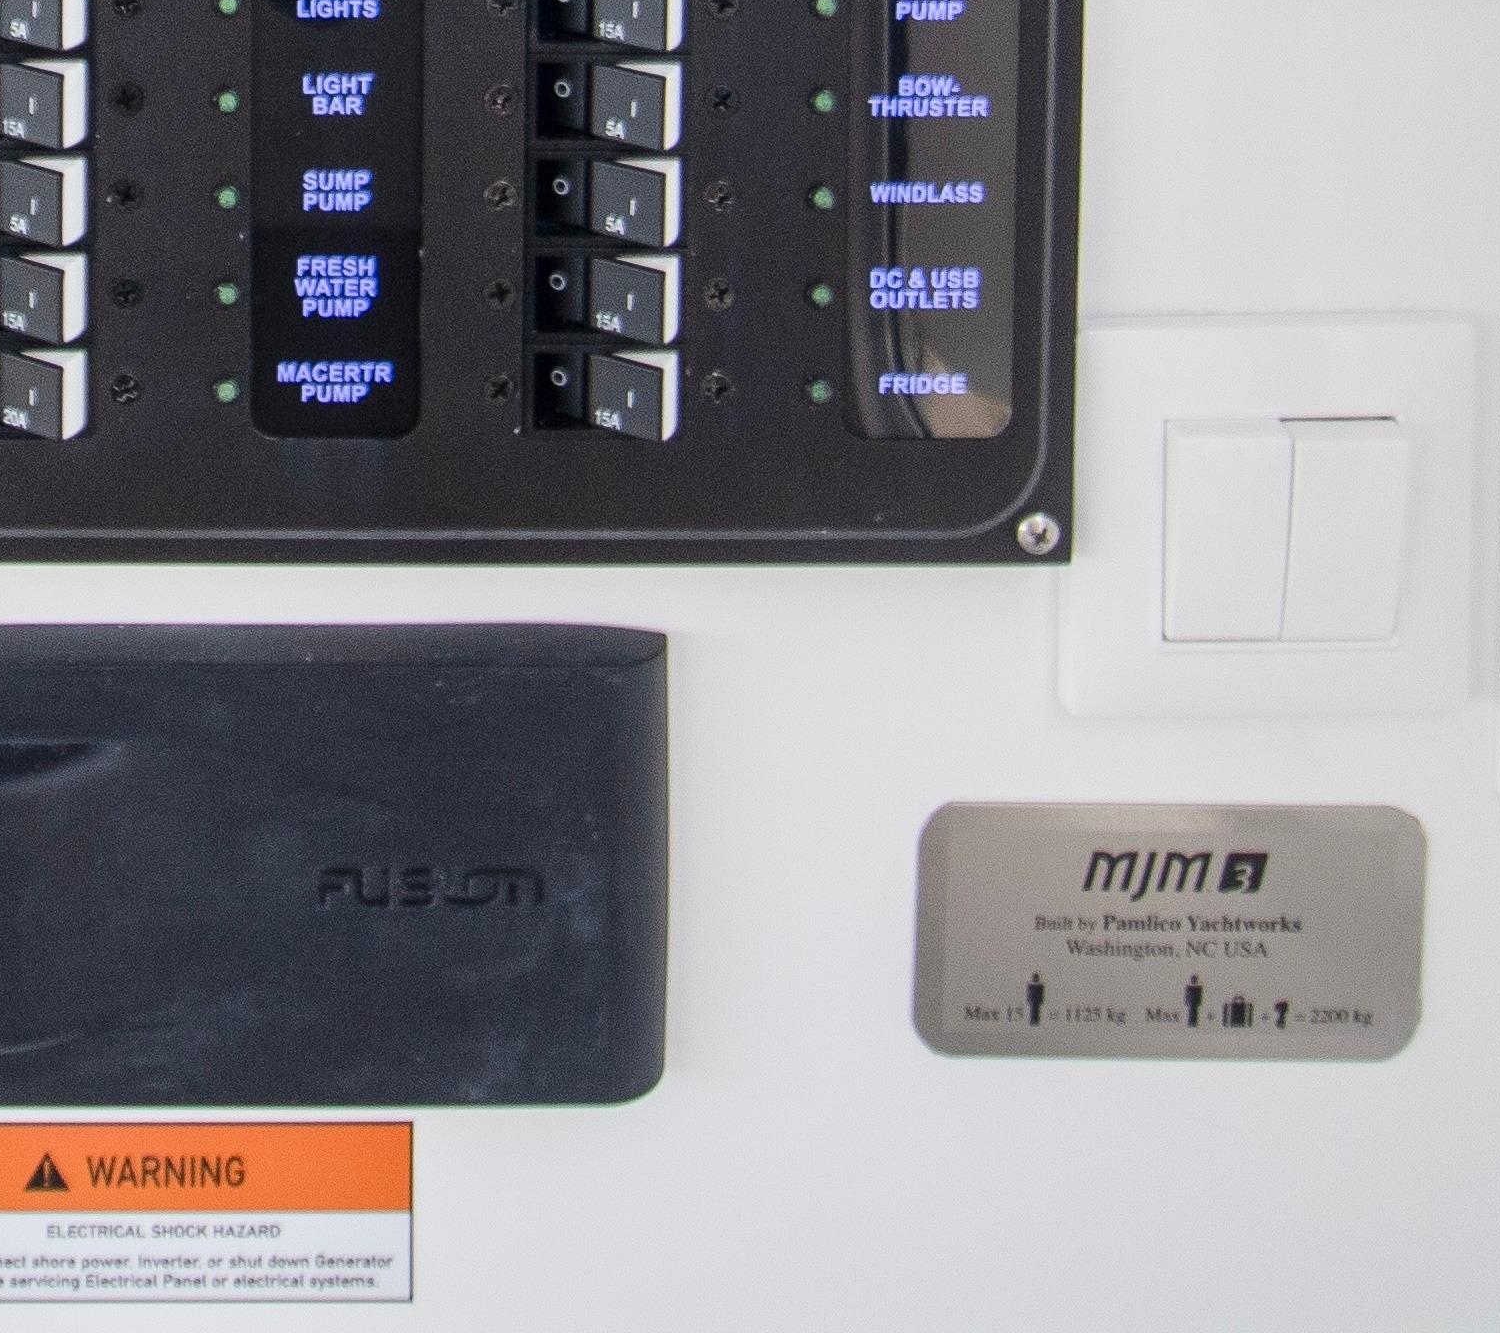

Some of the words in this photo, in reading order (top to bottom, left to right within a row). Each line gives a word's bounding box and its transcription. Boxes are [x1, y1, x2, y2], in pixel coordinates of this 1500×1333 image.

[896, 1, 962, 21] PUMP
[9, 21, 27, 39] 5A
[303, 75, 375, 94] LIGHT
[899, 78, 960, 97] BOW-
[313, 95, 363, 115] BAR
[868, 97, 988, 117] THRUSTER
[2, 119, 24, 137] 15A
[605, 121, 624, 138] 5A
[303, 170, 372, 190] SUMP
[303, 191, 371, 211] PUMP
[870, 183, 983, 204] WINDLASS
[9, 216, 27, 234] 5A
[605, 217, 624, 235] 5A
[297, 257, 377, 277] FRESH
[295, 278, 377, 298] WATER
[870, 269, 902, 289] DC
[907, 269, 926, 289] &
[931, 269, 981, 289] USB
[302, 298, 368, 317] PUMP
[870, 289, 979, 310] OUTLETS
[277, 362, 394, 383] MACERTR
[302, 383, 367, 403] PUMP
[878, 374, 968, 394] FRIDGE
[1035, 916, 1073, 931] Built
[1078, 917, 1097, 932] by
[1103, 915, 1182, 932] Pamlico
[1187, 916, 1302, 932] Yachtworks
[1066, 940, 1180, 961] Washington,
[1186, 940, 1218, 958] NC
[1224, 941, 1268, 958] USA
[86, 1155, 246, 1189] WARNING
[46, 1225, 145, 1238] ELECTRICAL
[151, 1225, 209, 1239] SHOCK
[213, 1225, 281, 1238] HAZARD
[32, 1255, 75, 1269] shore
[208, 1258, 222, 1269] or
[229, 1255, 262, 1269] shut
[268, 1255, 310, 1269] down
[316, 1255, 392, 1269] Generator
[10, 1275, 79, 1291] servicing
[86, 1275, 157, 1289] Electrical
[163, 1275, 208, 1289] Panel
[212, 1278, 227, 1289] or
[234, 1275, 304, 1289] electrical
